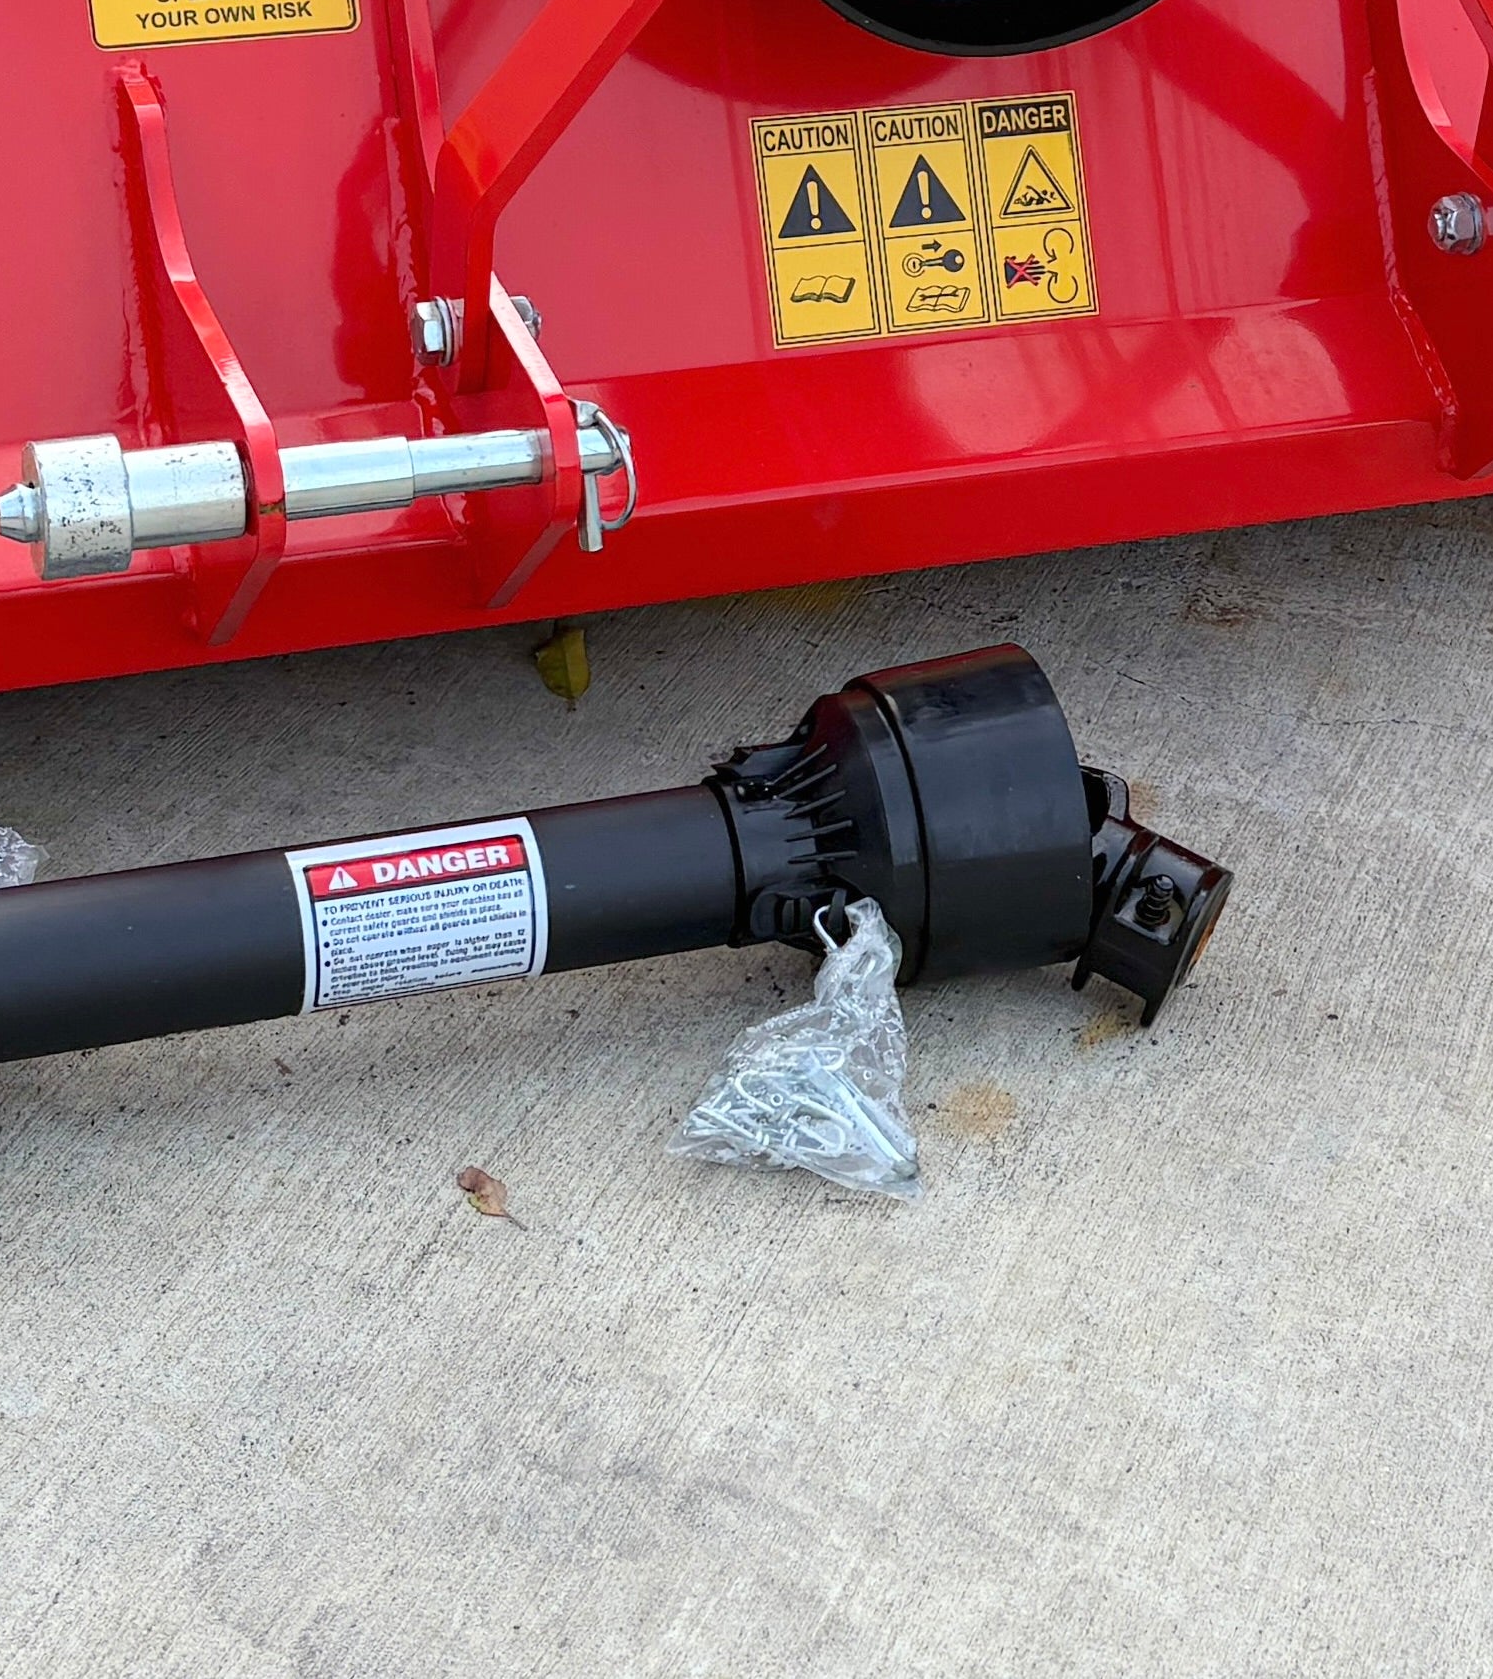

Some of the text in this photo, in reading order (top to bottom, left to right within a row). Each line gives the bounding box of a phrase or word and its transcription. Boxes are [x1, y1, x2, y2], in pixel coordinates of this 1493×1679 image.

[136, 1, 313, 29] YOUR OWN RISK
[875, 116, 958, 142] CAUTION
[982, 104, 1067, 133] DANGER
[763, 124, 849, 152] CAUTION
[372, 845, 509, 884] DANGER
[324, 906, 337, 915] TO
[340, 899, 384, 912] PREVENT
[388, 891, 432, 905] SERIOUS
[434, 886, 469, 898] INJURY
[473, 883, 487, 892] OR
